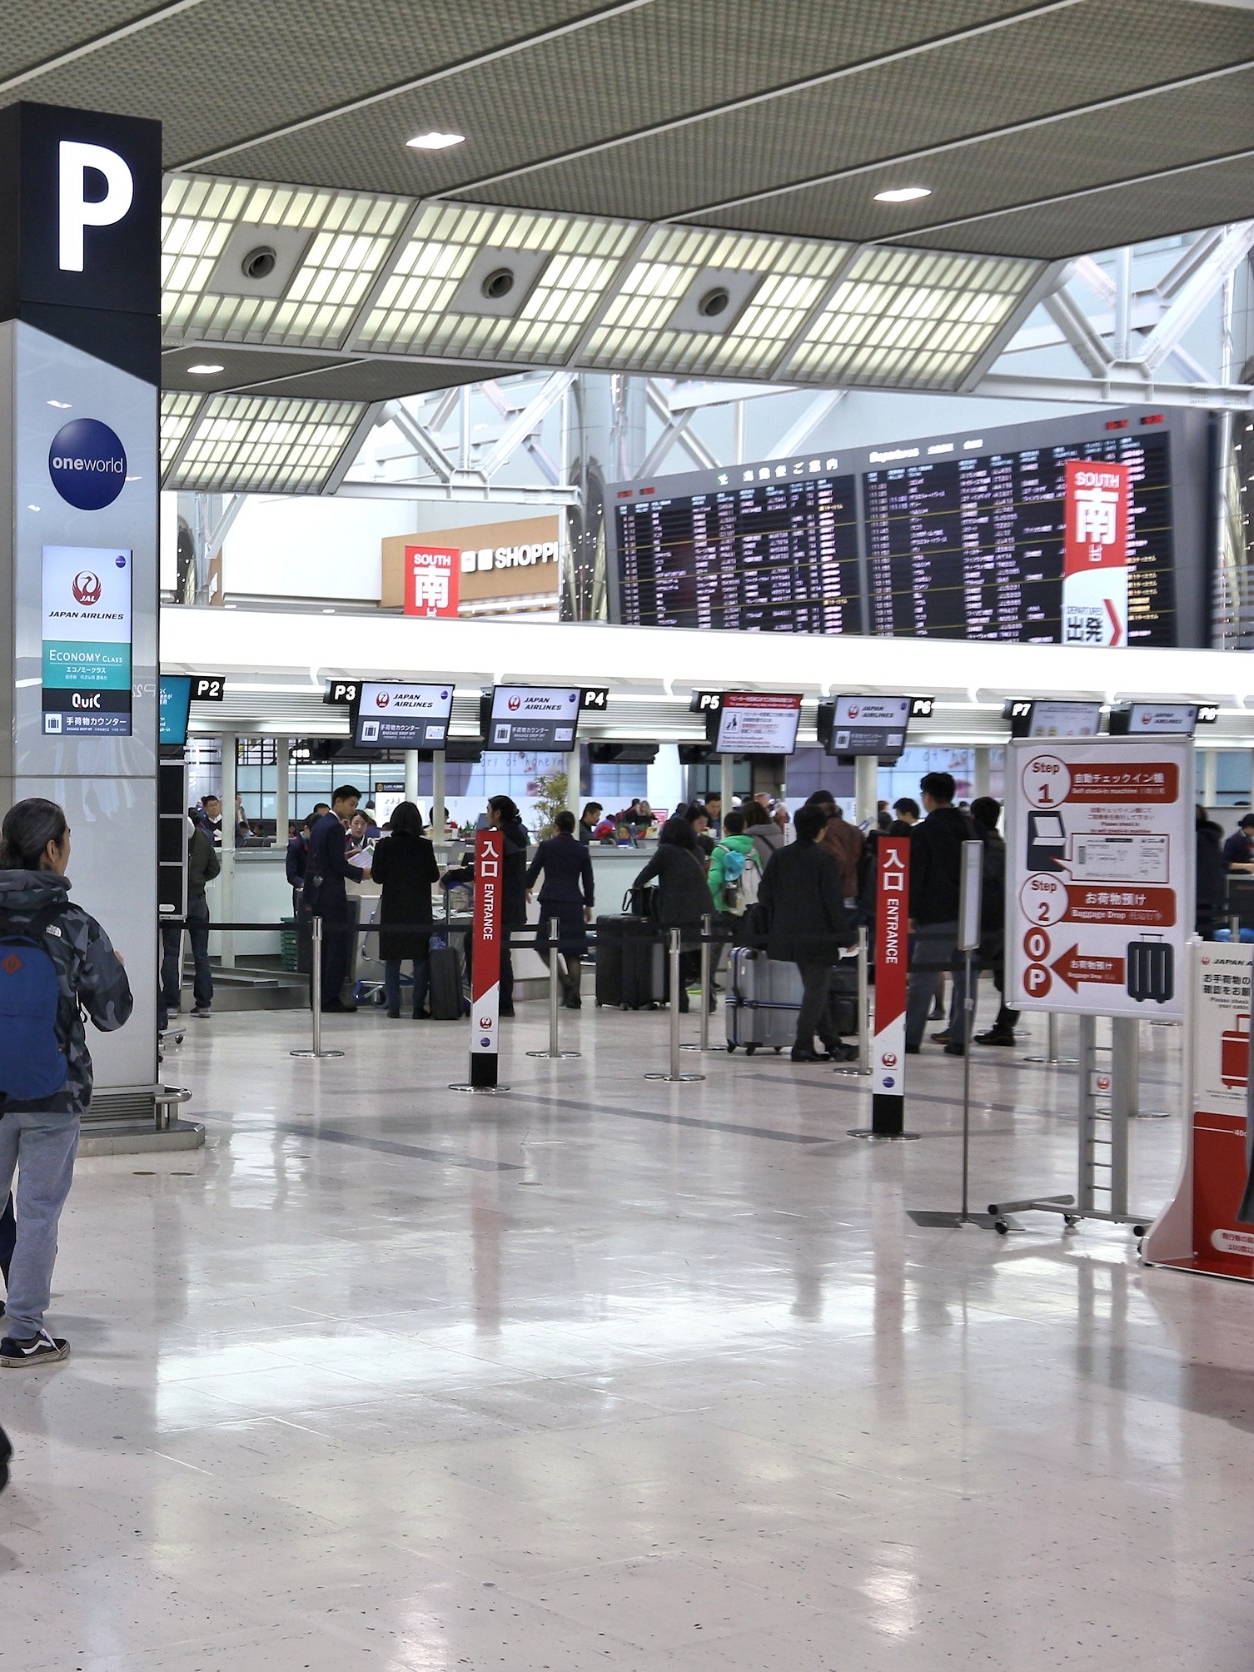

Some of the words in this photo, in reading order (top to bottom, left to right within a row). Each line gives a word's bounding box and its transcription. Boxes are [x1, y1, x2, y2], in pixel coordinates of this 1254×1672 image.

[58, 140, 134, 272] P
[52, 456, 124, 474] oneworld
[1074, 471, 1120, 488] SOUTH
[1074, 488, 1119, 545] 南
[413, 553, 452, 566] SOUTH
[494, 541, 559, 570] SHOPPI
[413, 565, 451, 609] 南
[48, 610, 79, 619] JAPAN
[80, 611, 124, 620] AIRLINES
[1066, 616, 1104, 642] 出発
[49, 649, 101, 662] ECONOMY
[102, 655, 123, 663] CLASS
[66, 666, 106, 674] エコノミークラス
[197, 680, 220, 697] P2
[334, 684, 356, 701] P3
[584, 691, 605, 706] P4
[699, 695, 720, 710] P5
[912, 700, 932, 715] P6
[1011, 702, 1032, 717] P7
[66, 716, 127, 726] 手荷物カウンター
[1032, 761, 1060, 775] Step
[1074, 772, 1165, 784] 自動チェックイン機
[1037, 783, 1054, 804] 1
[480, 840, 500, 878] 入口
[882, 848, 905, 891] 入口
[1031, 880, 1057, 893] Step
[1085, 892, 1147, 906] お荷物預け
[482, 883, 494, 941] ENTRANCE
[1038, 902, 1051, 922] 2
[1071, 909, 1106, 919] Baggage
[1107, 911, 1127, 920] Drop
[885, 898, 900, 964] ENTRANCE
[1029, 969, 1046, 990] P
